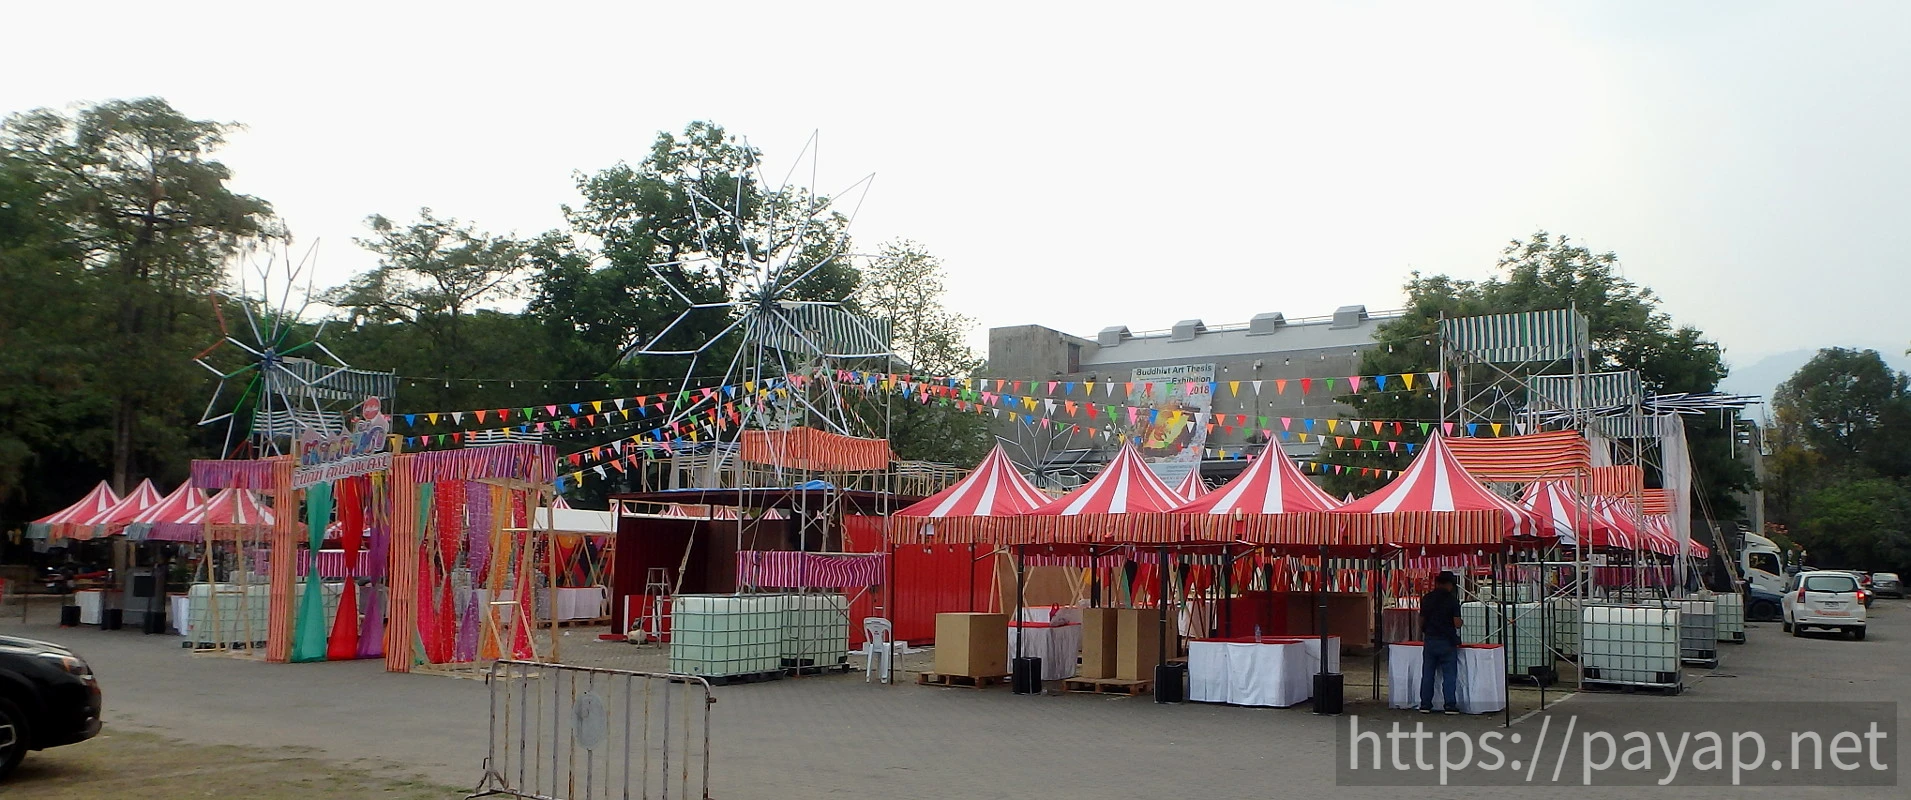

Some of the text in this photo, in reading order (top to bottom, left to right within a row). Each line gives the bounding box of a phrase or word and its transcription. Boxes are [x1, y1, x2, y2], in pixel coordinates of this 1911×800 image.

[1136, 364, 1212, 376] Buddhist Art Thesis
[1171, 376, 1211, 385] Exhibition
